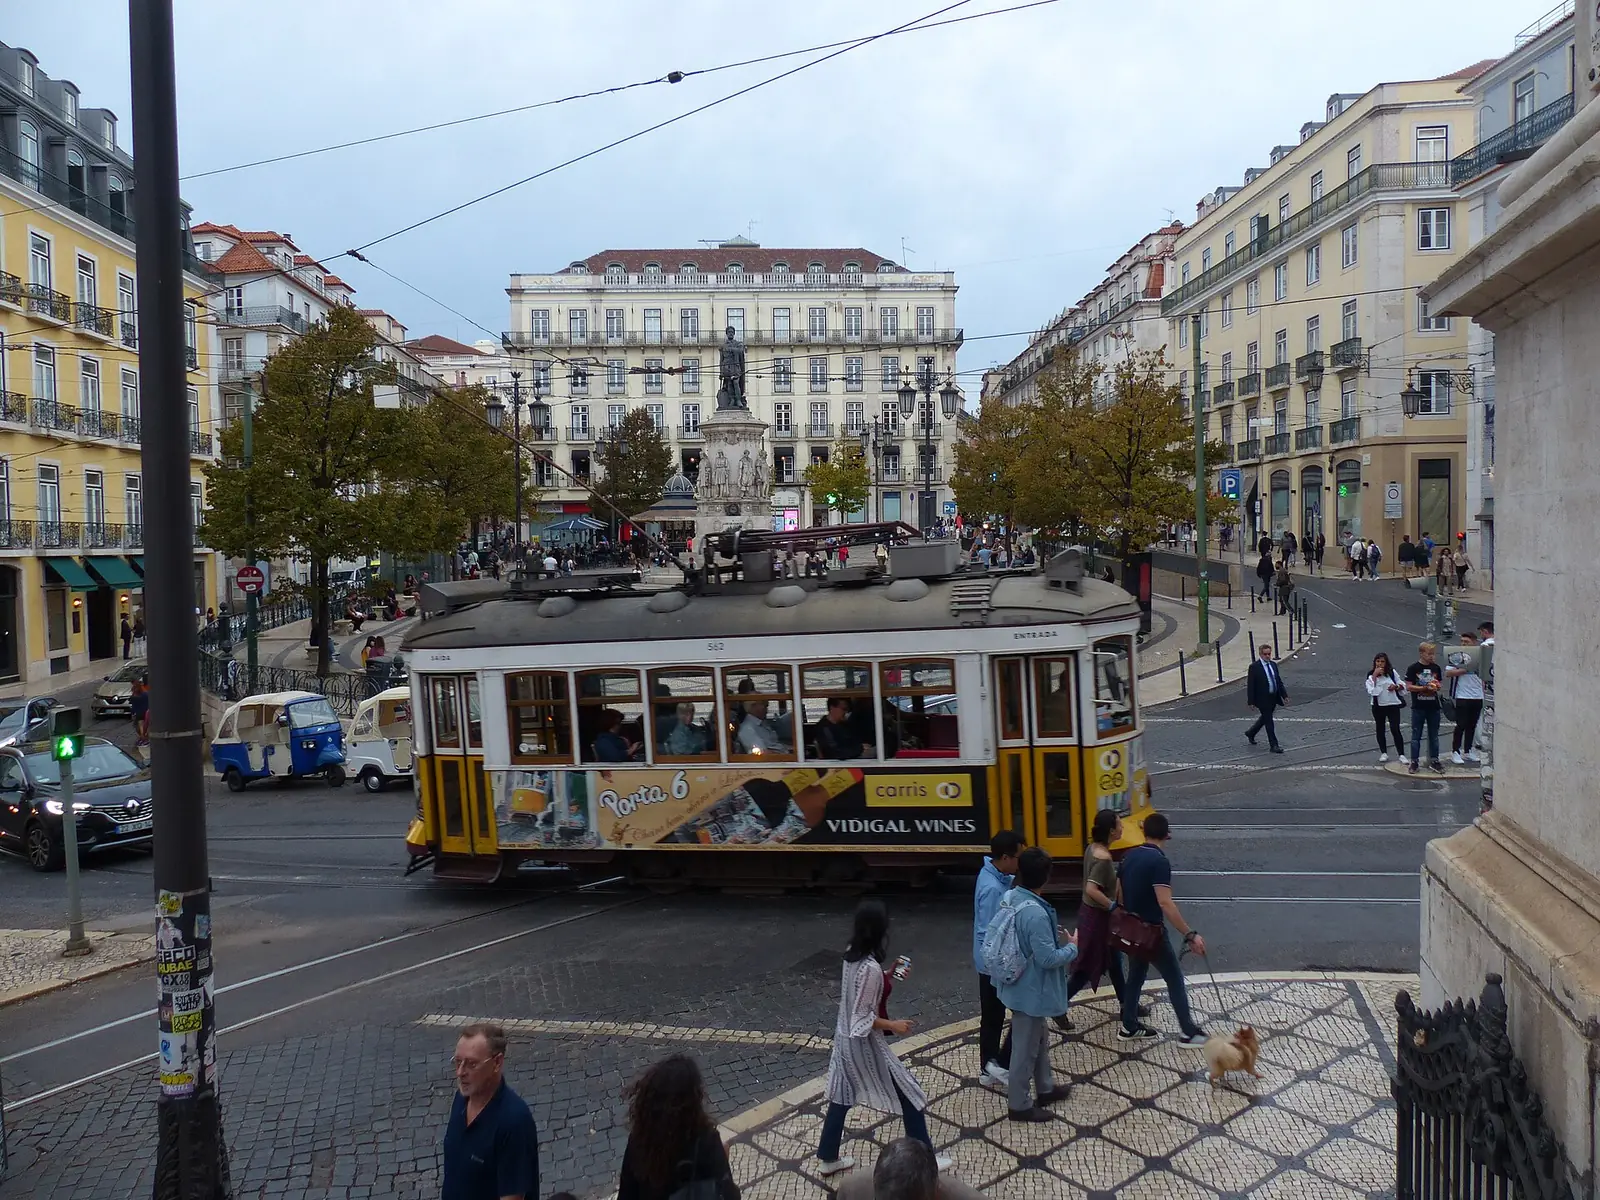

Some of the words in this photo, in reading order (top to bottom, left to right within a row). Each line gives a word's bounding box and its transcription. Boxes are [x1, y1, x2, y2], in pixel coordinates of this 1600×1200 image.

[1225, 478, 1236, 493] P
[1013, 631, 1059, 640] ENTRADA
[598, 784, 668, 818] Porta
[669, 769, 690, 799] 6
[876, 782, 928, 797] carris
[826, 818, 912, 833] VIDIGAL
[914, 819, 977, 833] WINES
